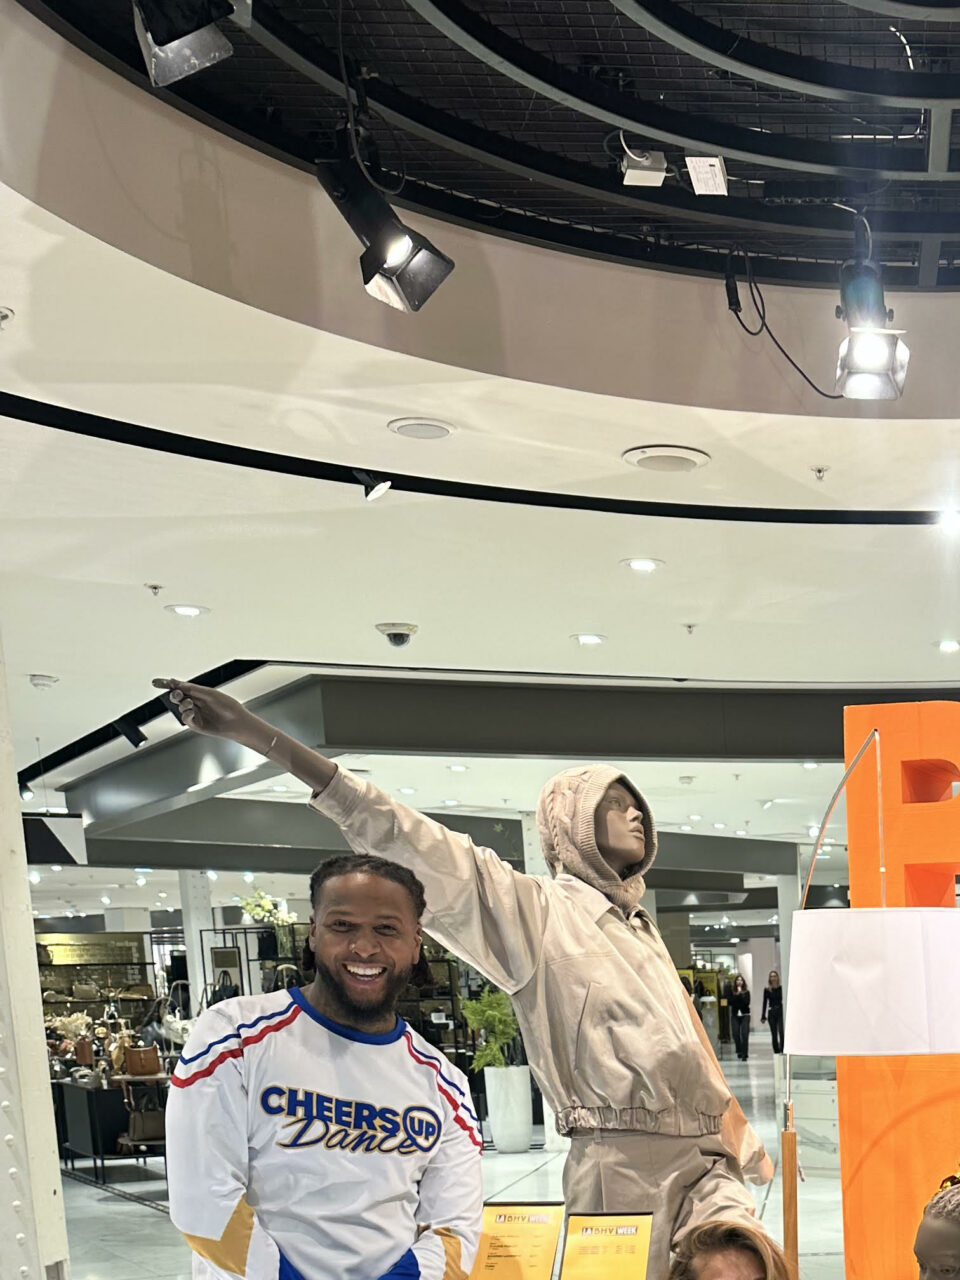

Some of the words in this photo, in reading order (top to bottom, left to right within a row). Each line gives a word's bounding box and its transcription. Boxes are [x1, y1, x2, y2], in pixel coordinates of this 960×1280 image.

[260, 1085, 402, 1134] CHEERS
[408, 1114, 437, 1140] UP
[277, 1117, 418, 1155] Dance
[616, 1226, 638, 1236] WEEK
